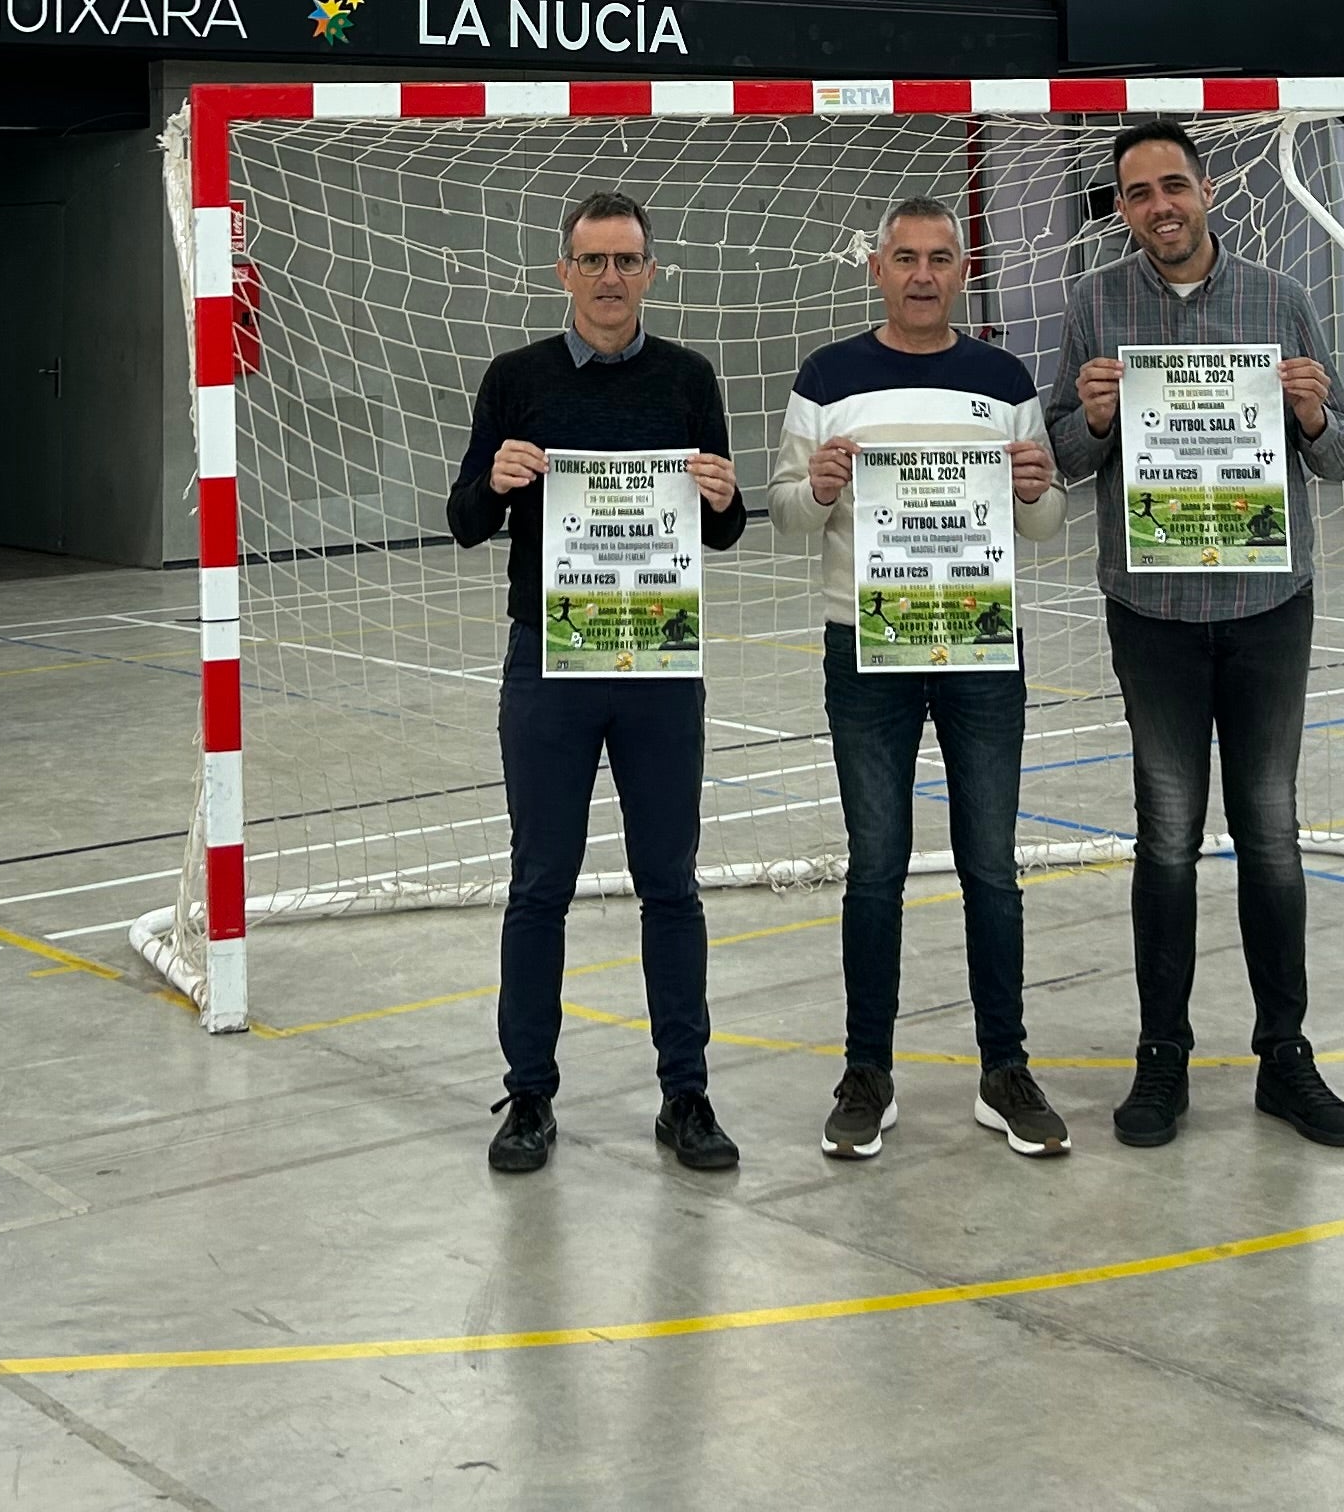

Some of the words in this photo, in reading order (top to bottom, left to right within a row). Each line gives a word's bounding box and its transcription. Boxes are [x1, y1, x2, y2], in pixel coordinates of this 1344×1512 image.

[1187, 354, 1226, 367] FUTBOL
[1230, 353, 1270, 367] PENYES
[1166, 370, 1201, 383] NADAL
[1204, 369, 1234, 382] 2024
[1169, 418, 1206, 431] FUTBOL
[1208, 418, 1235, 430] SALA
[920, 451, 958, 465] FUTBOL
[962, 450, 1001, 464] PENYES
[609, 460, 646, 474] FUTBOL
[899, 467, 933, 480] NADAL
[937, 466, 965, 479] 2024
[1139, 468, 1160, 479] PLAY
[1162, 468, 1173, 478] EA
[588, 476, 622, 489] NADAL
[625, 475, 653, 488] 2024
[901, 516, 937, 529] FUTBOL
[940, 515, 966, 528] SALA
[589, 524, 625, 536] FUTBOL
[628, 524, 653, 536] SALA
[558, 573, 579, 584] PLAY
[581, 573, 592, 583] EA
[870, 567, 891, 578] PLAY
[893, 567, 904, 577] EA
